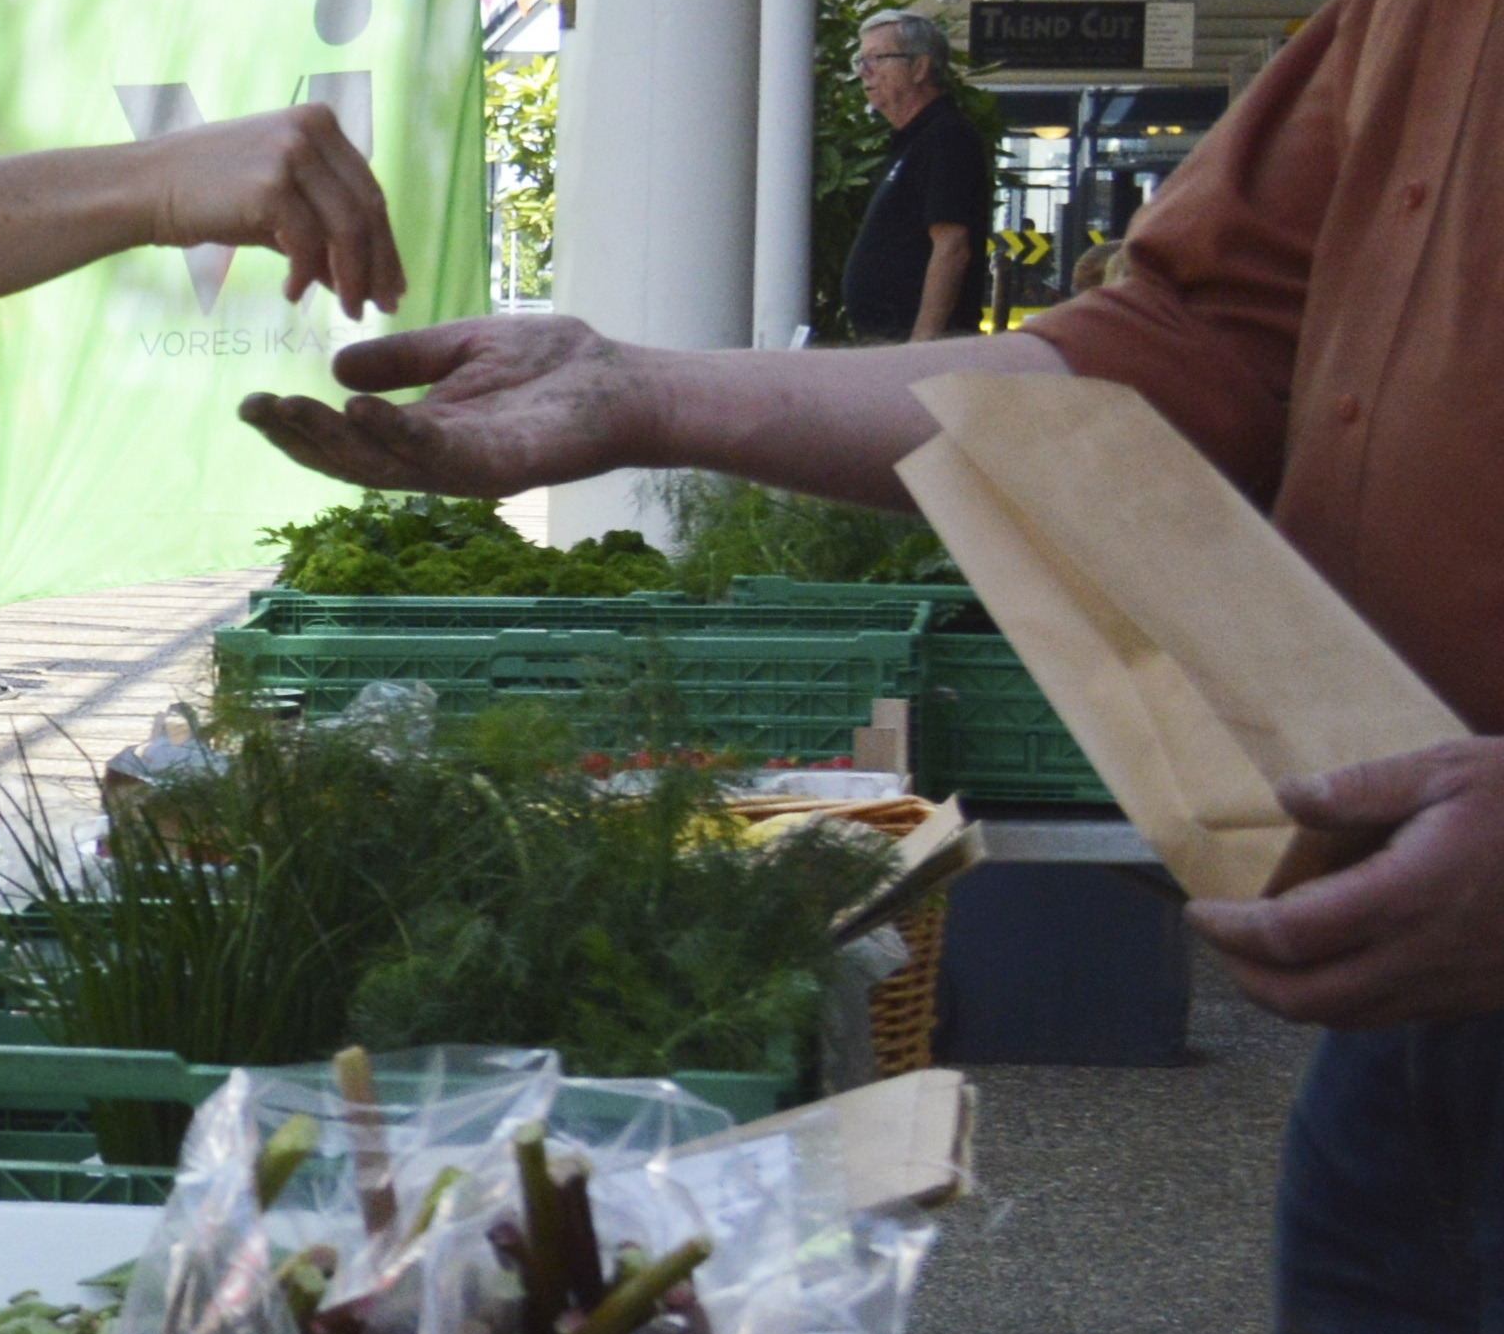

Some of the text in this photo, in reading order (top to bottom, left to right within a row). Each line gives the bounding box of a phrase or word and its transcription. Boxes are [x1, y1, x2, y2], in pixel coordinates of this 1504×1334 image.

[979, 6, 1072, 40] TREND
[1079, 7, 1136, 40] CUT
[139, 329, 252, 357] VORES
